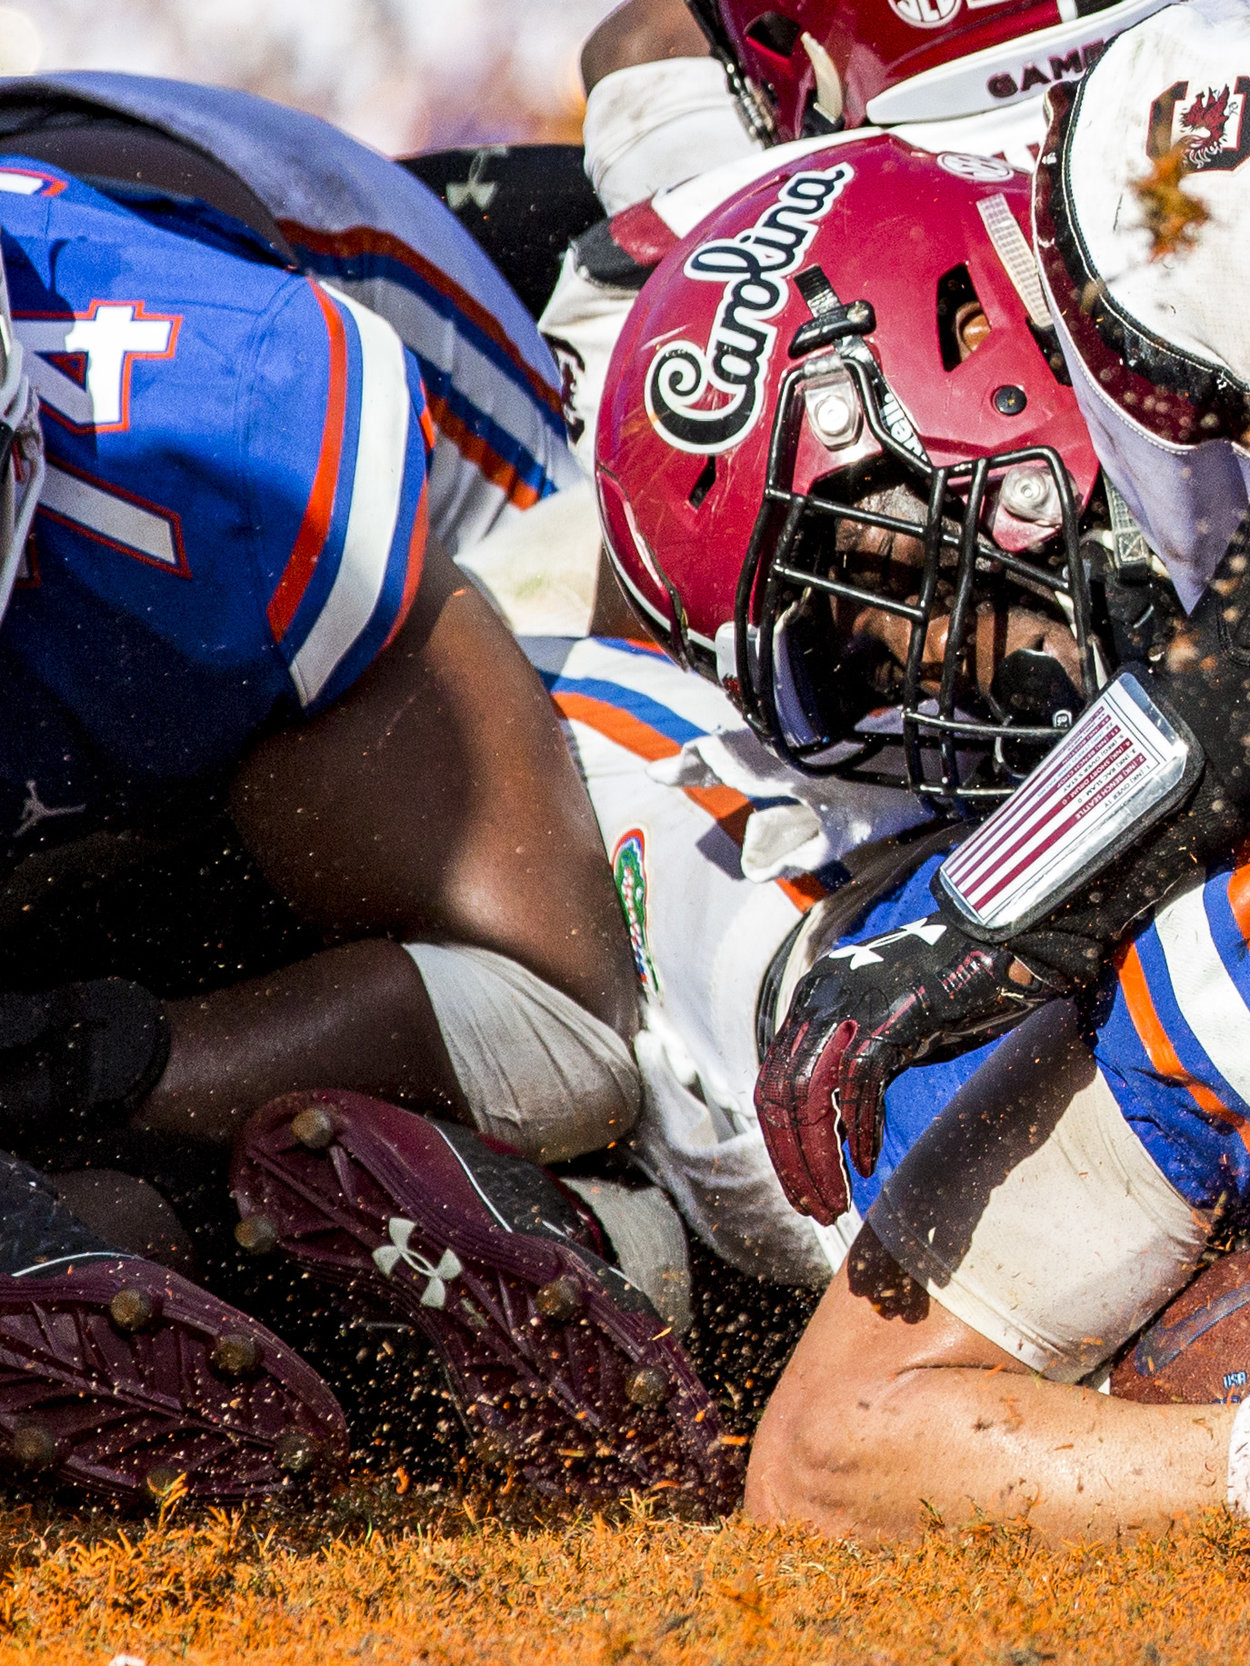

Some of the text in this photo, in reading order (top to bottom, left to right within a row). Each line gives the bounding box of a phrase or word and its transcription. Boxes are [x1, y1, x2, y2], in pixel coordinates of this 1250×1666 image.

[647, 163, 854, 453] Carolina
[1087, 757, 1111, 781] SHORT
[1099, 772, 1124, 796] BENCH
[1073, 792, 1103, 820] SEATTLE
[1223, 1370, 1248, 1390] USA
